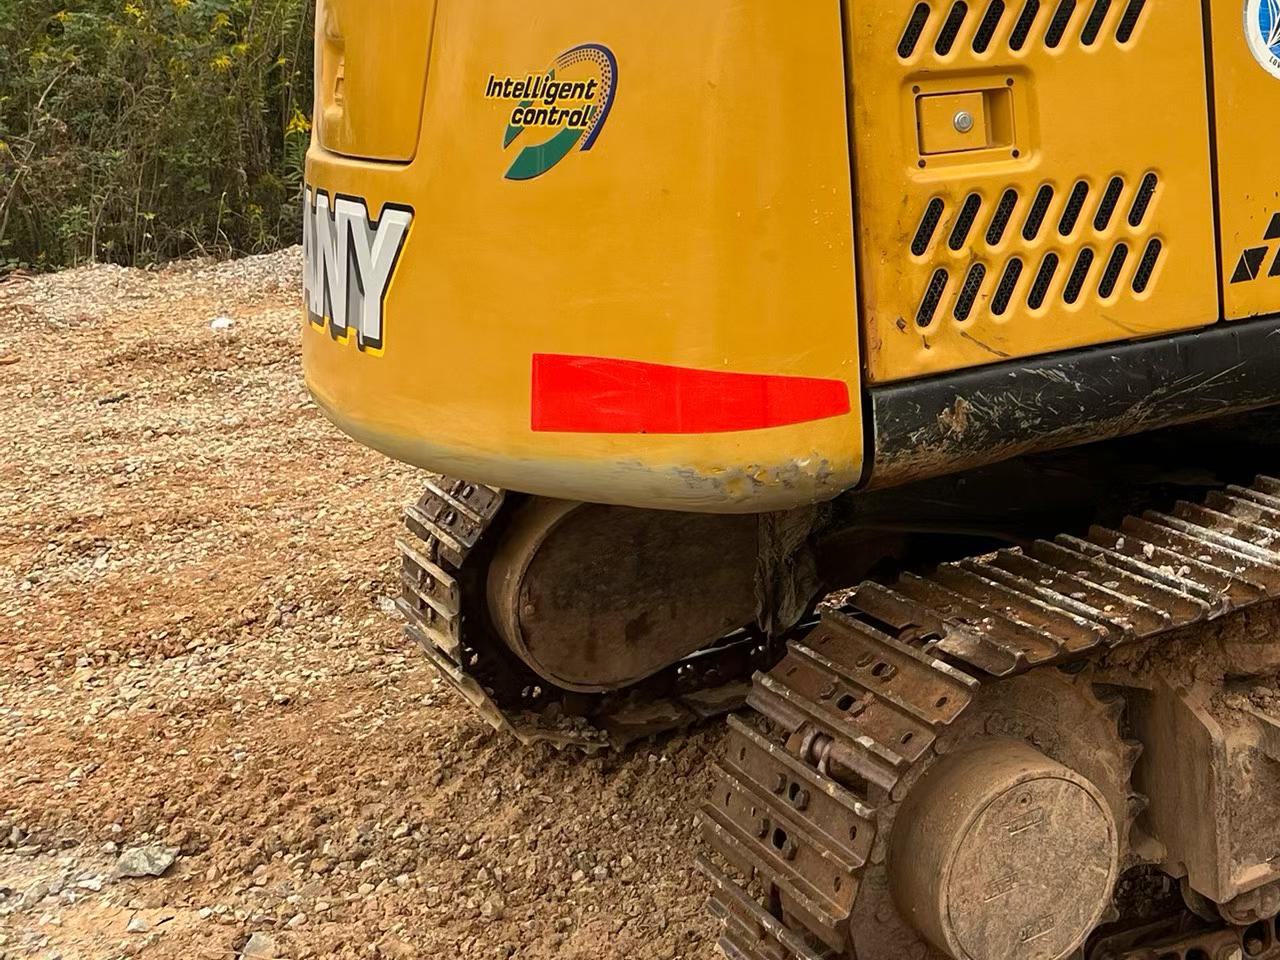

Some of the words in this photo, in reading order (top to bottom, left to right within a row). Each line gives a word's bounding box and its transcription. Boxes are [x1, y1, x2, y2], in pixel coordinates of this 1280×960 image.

[485, 75, 598, 105] Intelligent
[511, 105, 592, 127] control
[303, 187, 414, 346] ANY
